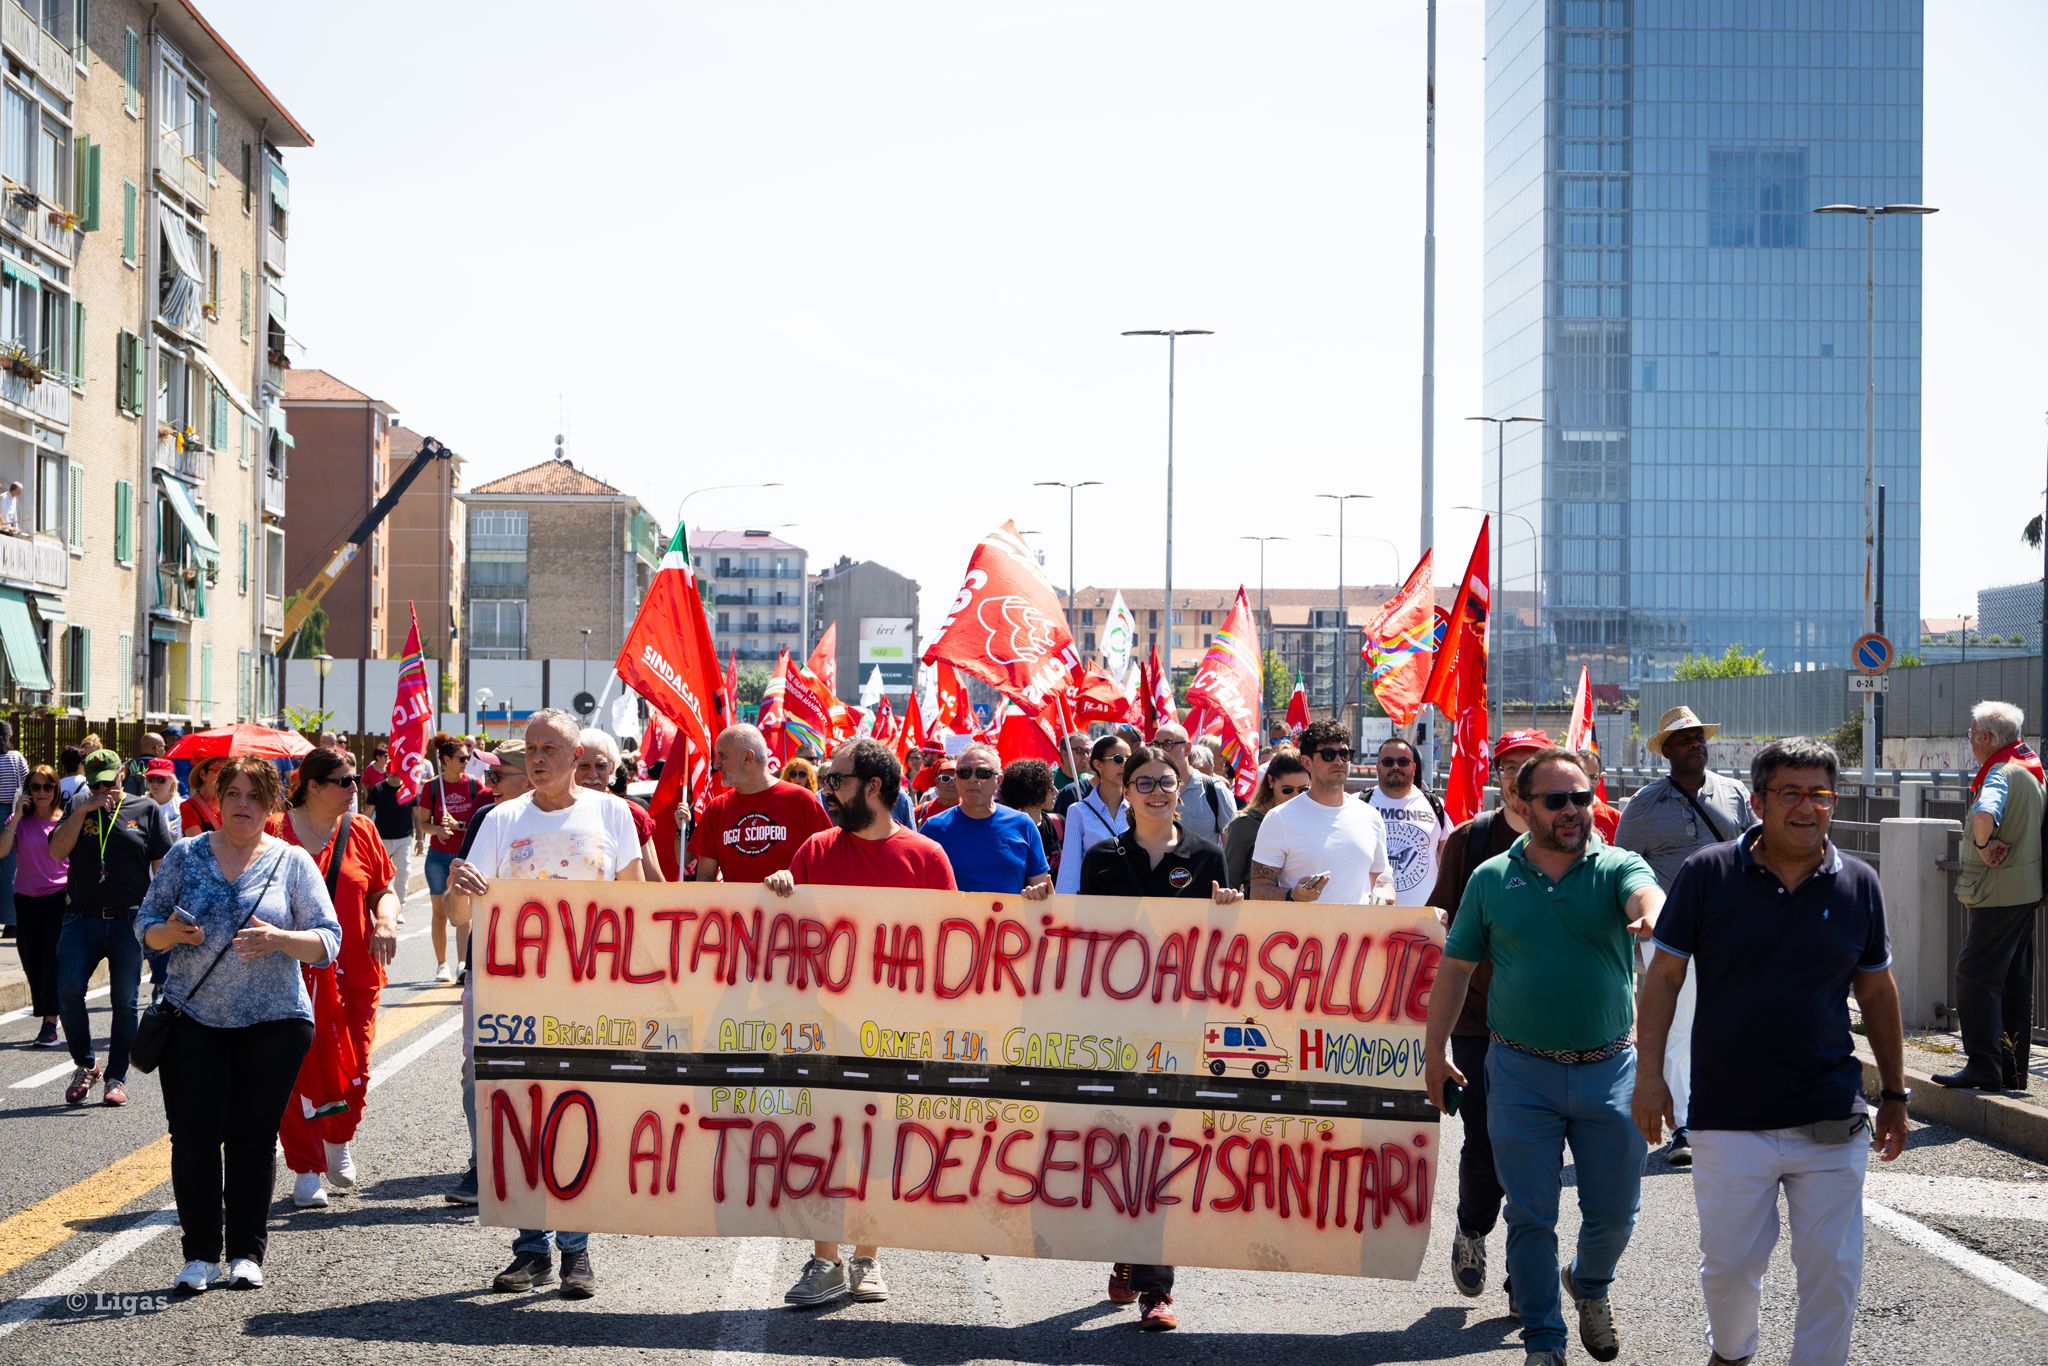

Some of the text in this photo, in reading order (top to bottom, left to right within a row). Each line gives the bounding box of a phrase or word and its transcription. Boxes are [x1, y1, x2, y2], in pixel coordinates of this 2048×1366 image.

[876, 624, 897, 635] ieri
[1856, 680, 1874, 688] 0-24
[1376, 806, 1434, 823] MONES
[723, 825, 787, 845] OGGI SCIOPERO
[486, 900, 549, 978] LA
[874, 923, 924, 993] HA
[1152, 926, 1249, 1008] ALLA
[1257, 931, 1440, 1022] SALUTE
[477, 1013, 537, 1045] SS28
[596, 1015, 637, 1046] ALTA
[719, 1018, 777, 1052] ALTO
[860, 1020, 933, 1059] ORMEA
[1325, 1033, 1426, 1076] MONDOV
[896, 1093, 1040, 1123] BAGNASCO
[1202, 1110, 1335, 1140] NUCETTO
[490, 1084, 599, 1202] NO
